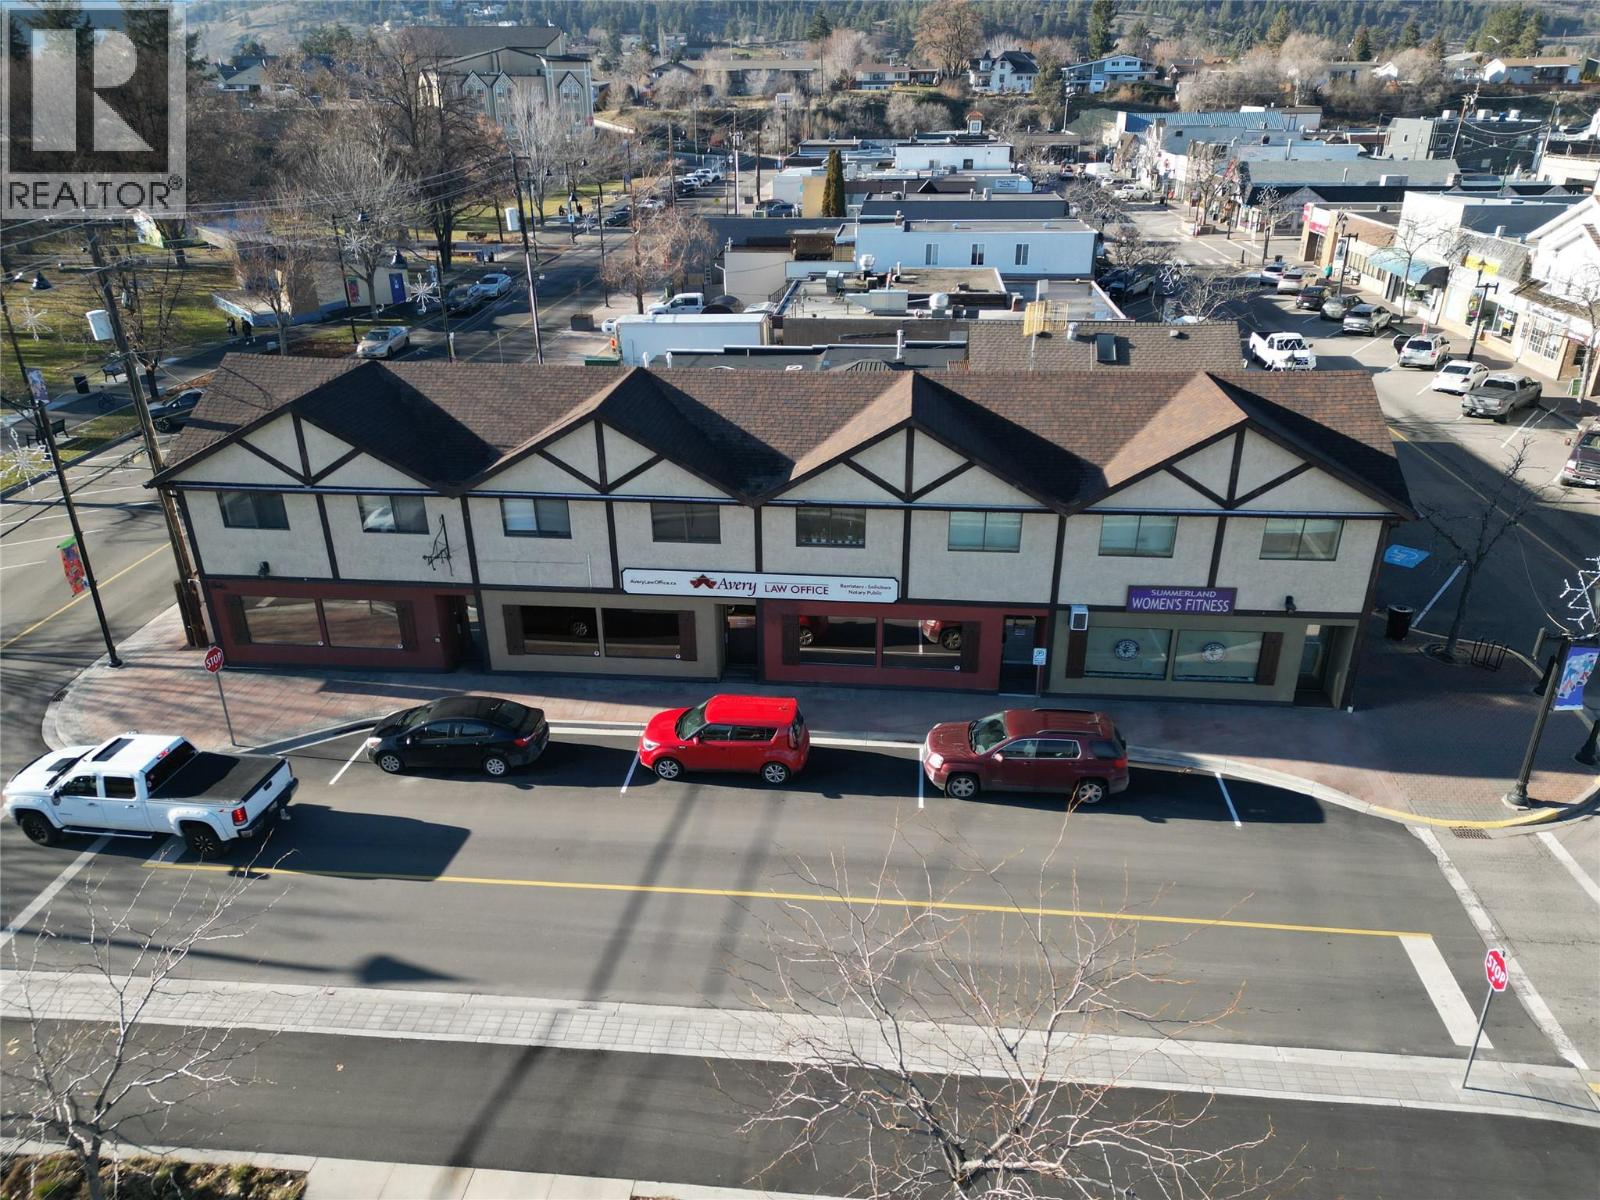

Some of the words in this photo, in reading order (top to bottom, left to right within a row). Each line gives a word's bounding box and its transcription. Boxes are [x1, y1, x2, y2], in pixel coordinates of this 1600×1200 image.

[717, 577, 757, 597] Avery
[764, 584, 787, 593] LAW
[790, 585, 829, 595] OFFICE
[1151, 589, 1217, 598] SUMMERLAND
[1132, 597, 1182, 611] WOMEN'S
[1185, 599, 1230, 612] FITNESS
[206, 651, 222, 669] STOP
[1487, 954, 1506, 983] STOP
